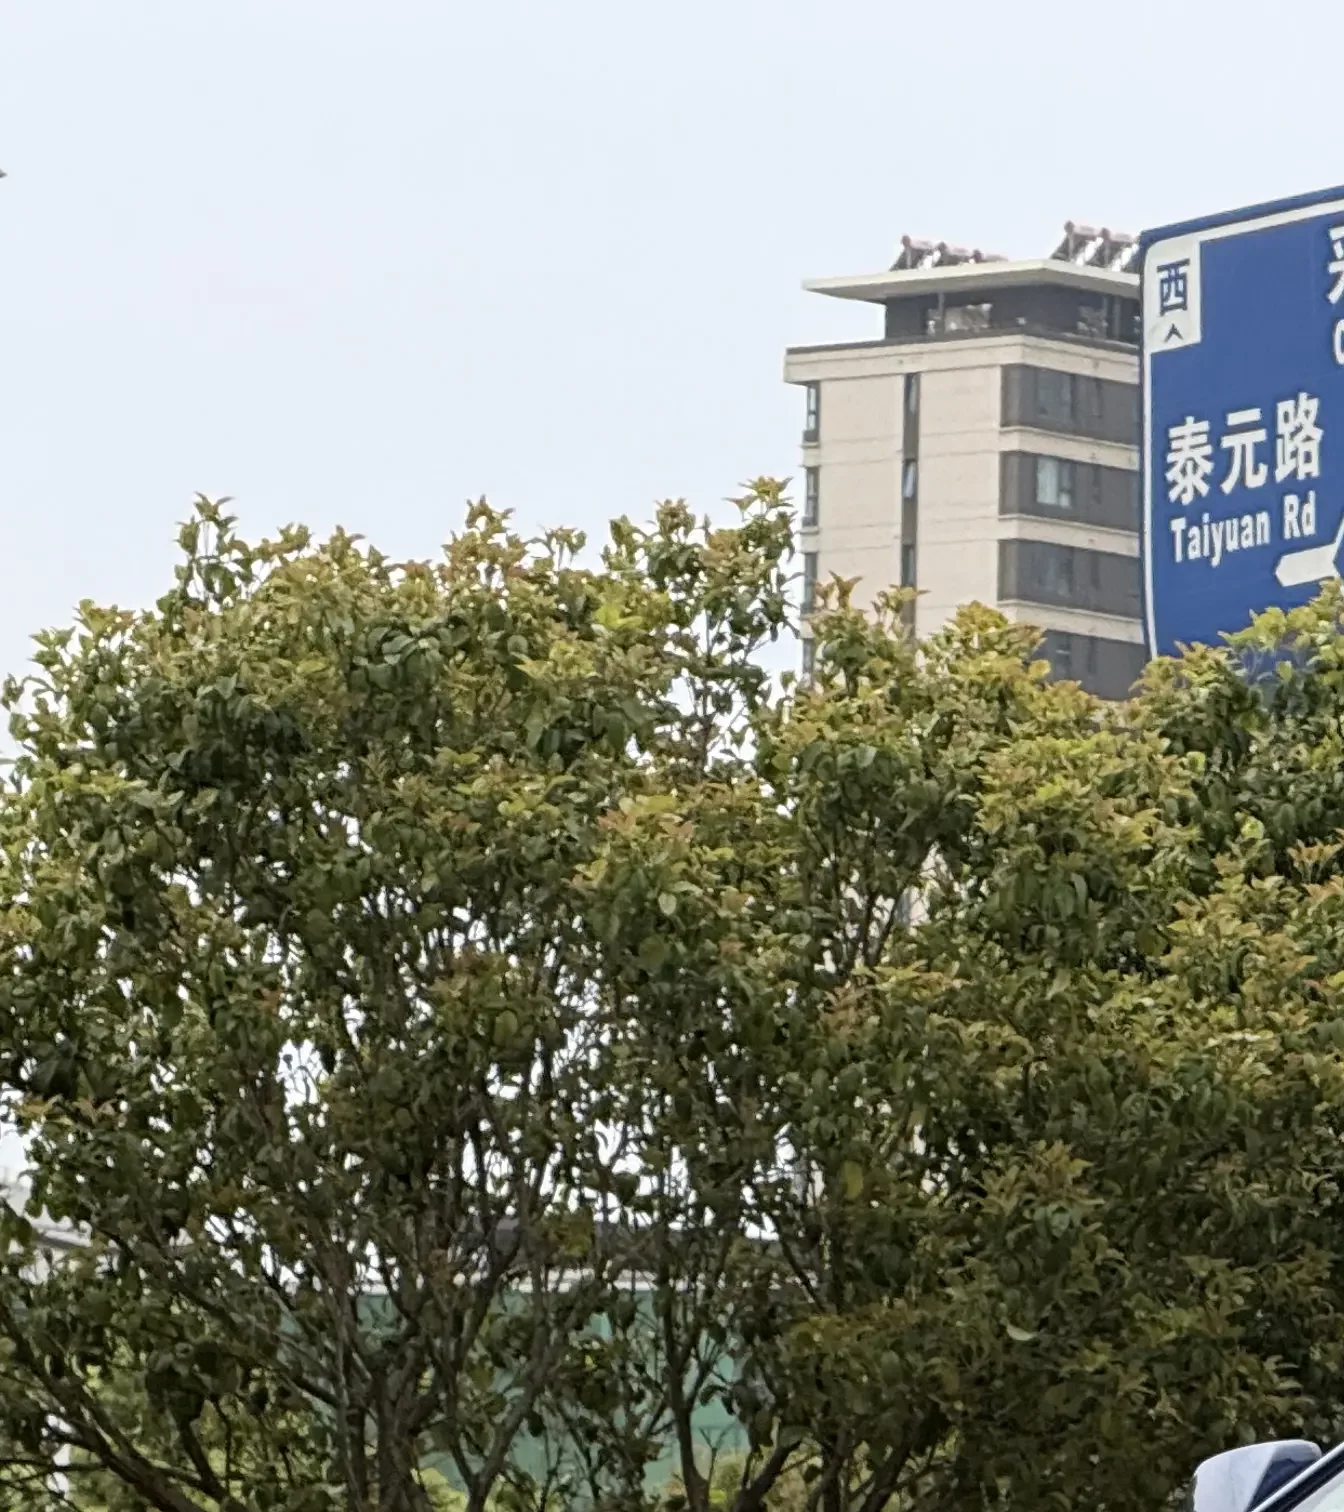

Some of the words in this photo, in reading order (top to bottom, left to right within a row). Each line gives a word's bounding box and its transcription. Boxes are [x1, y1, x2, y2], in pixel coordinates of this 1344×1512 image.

[1156, 258, 1190, 317] 西
[1165, 392, 1324, 506] 泰元路
[1171, 510, 1270, 567] Taiyuan
[1283, 492, 1317, 539] Rd
